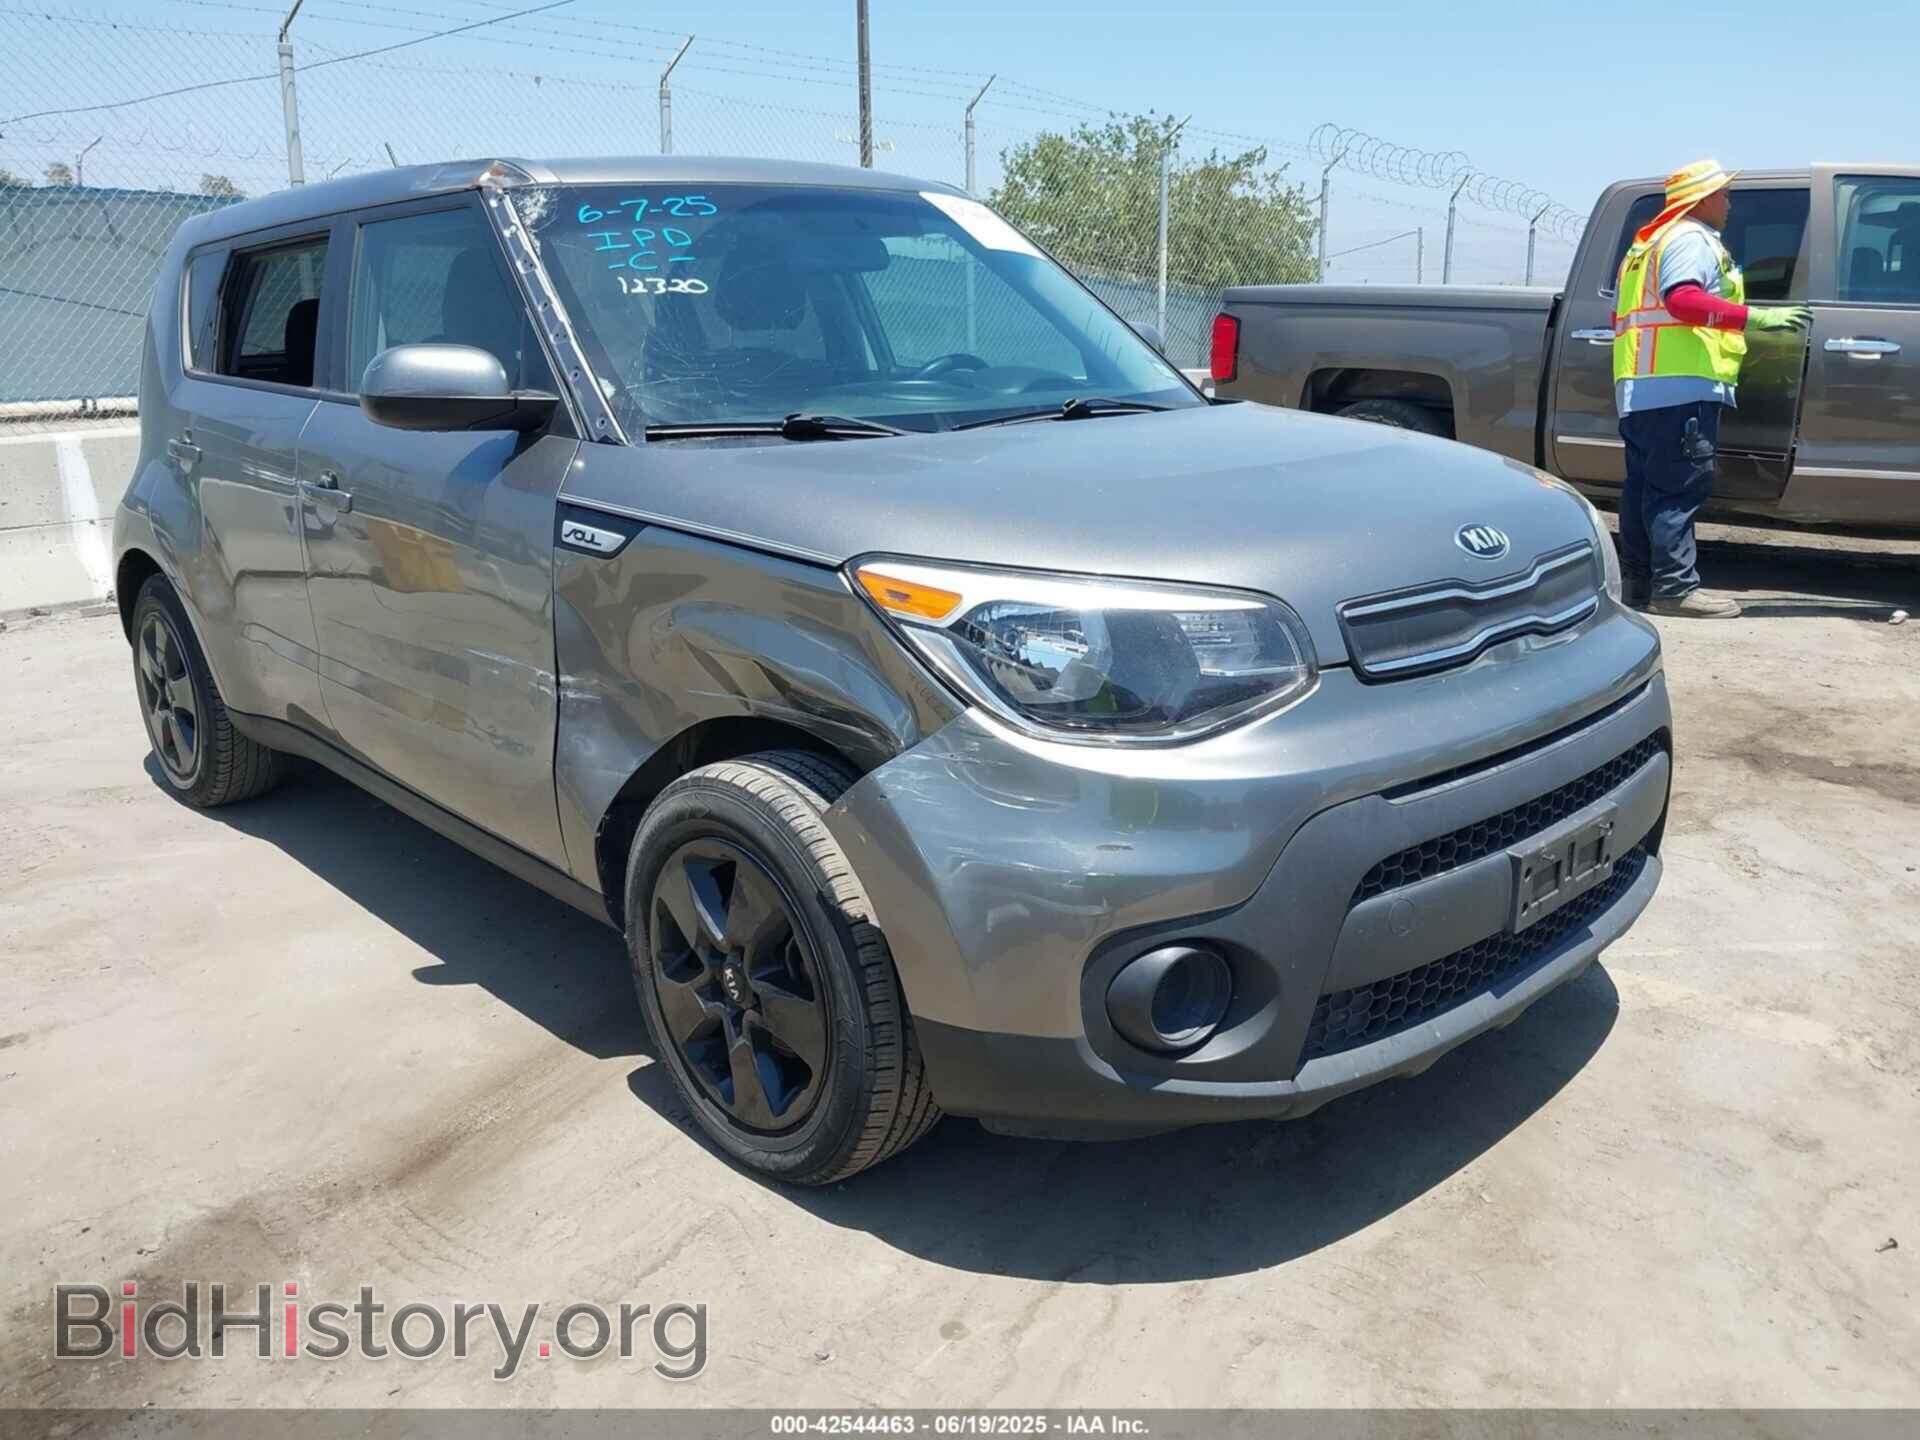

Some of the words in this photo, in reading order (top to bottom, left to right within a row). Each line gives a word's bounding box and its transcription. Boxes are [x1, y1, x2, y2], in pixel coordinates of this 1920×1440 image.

[578, 196, 718, 223] 6-7-25
[617, 276, 708, 294] 12320
[563, 528, 602, 547] SOUL
[1461, 526, 1506, 551] KIA
[724, 967, 740, 1000] KIA
